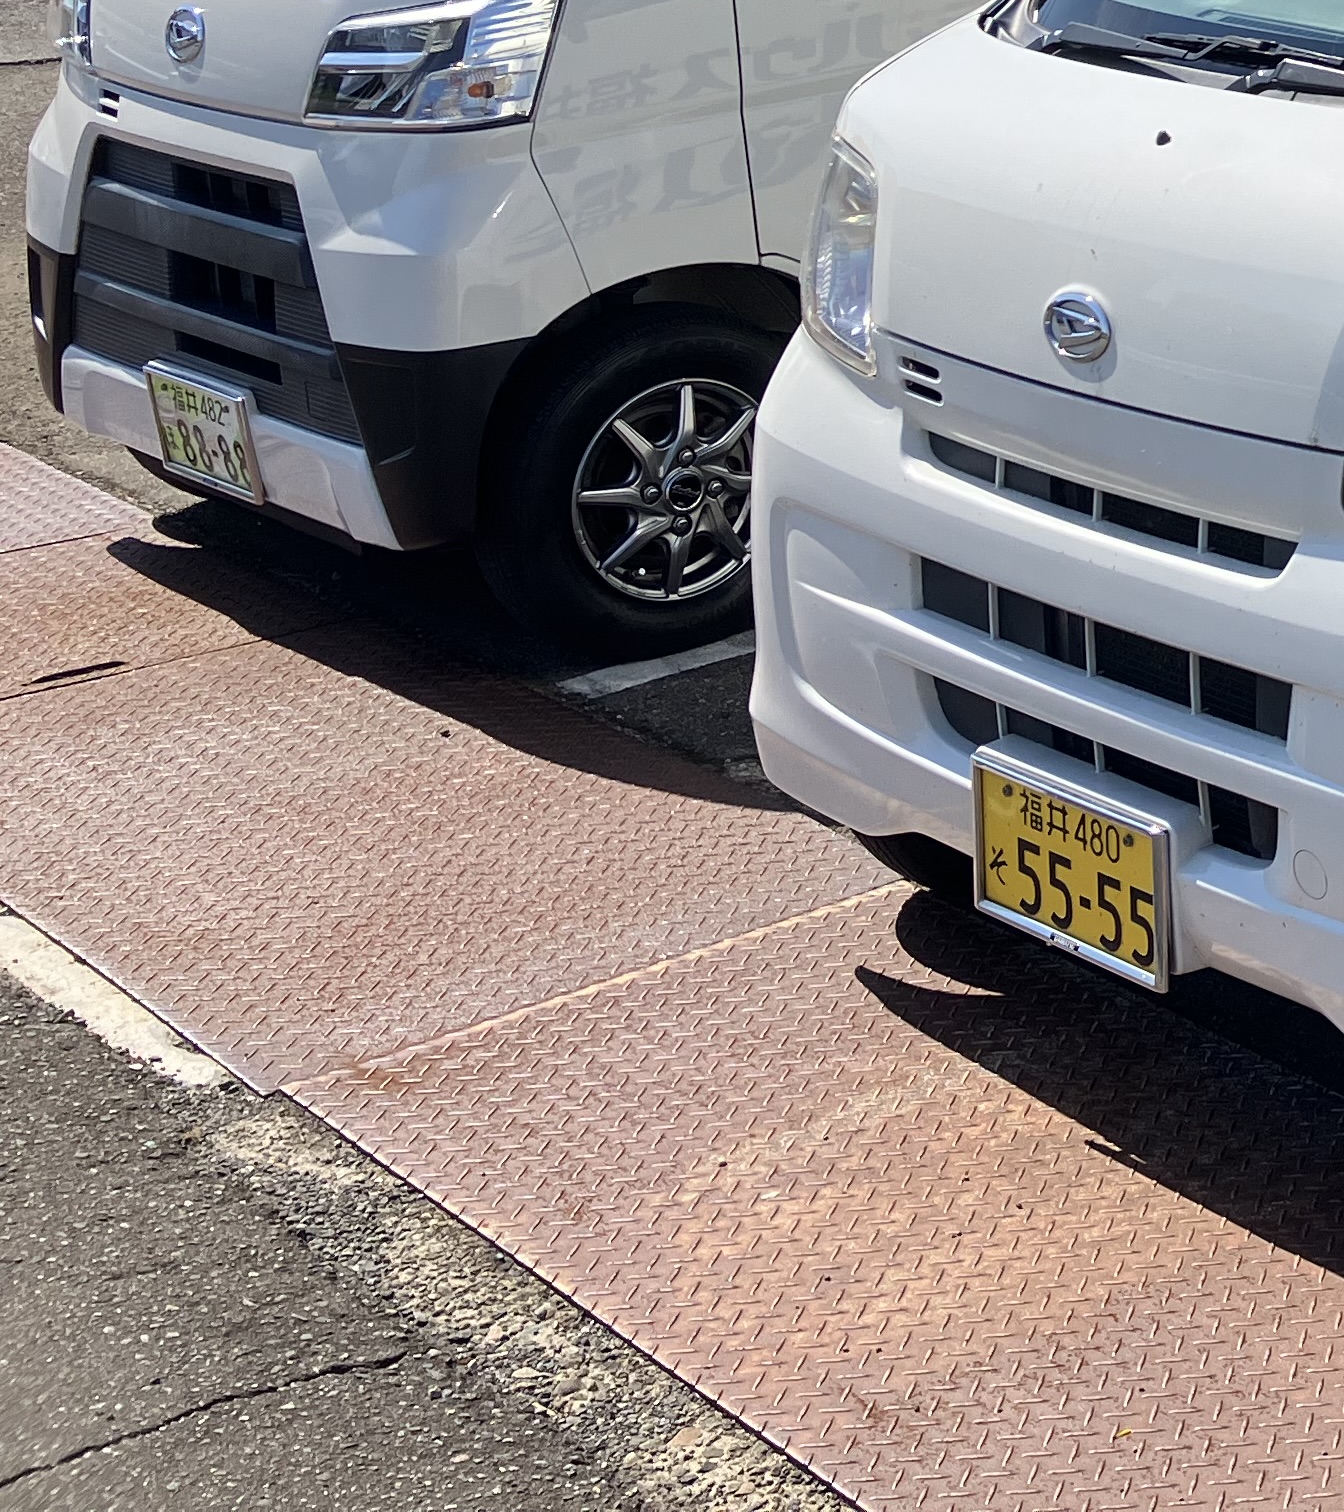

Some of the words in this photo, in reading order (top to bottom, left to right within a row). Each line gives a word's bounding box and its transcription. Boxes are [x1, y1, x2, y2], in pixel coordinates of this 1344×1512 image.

[1020, 789, 1120, 864] 福井480
[989, 845, 1008, 885] そ
[1017, 836, 1155, 967] 55-55
